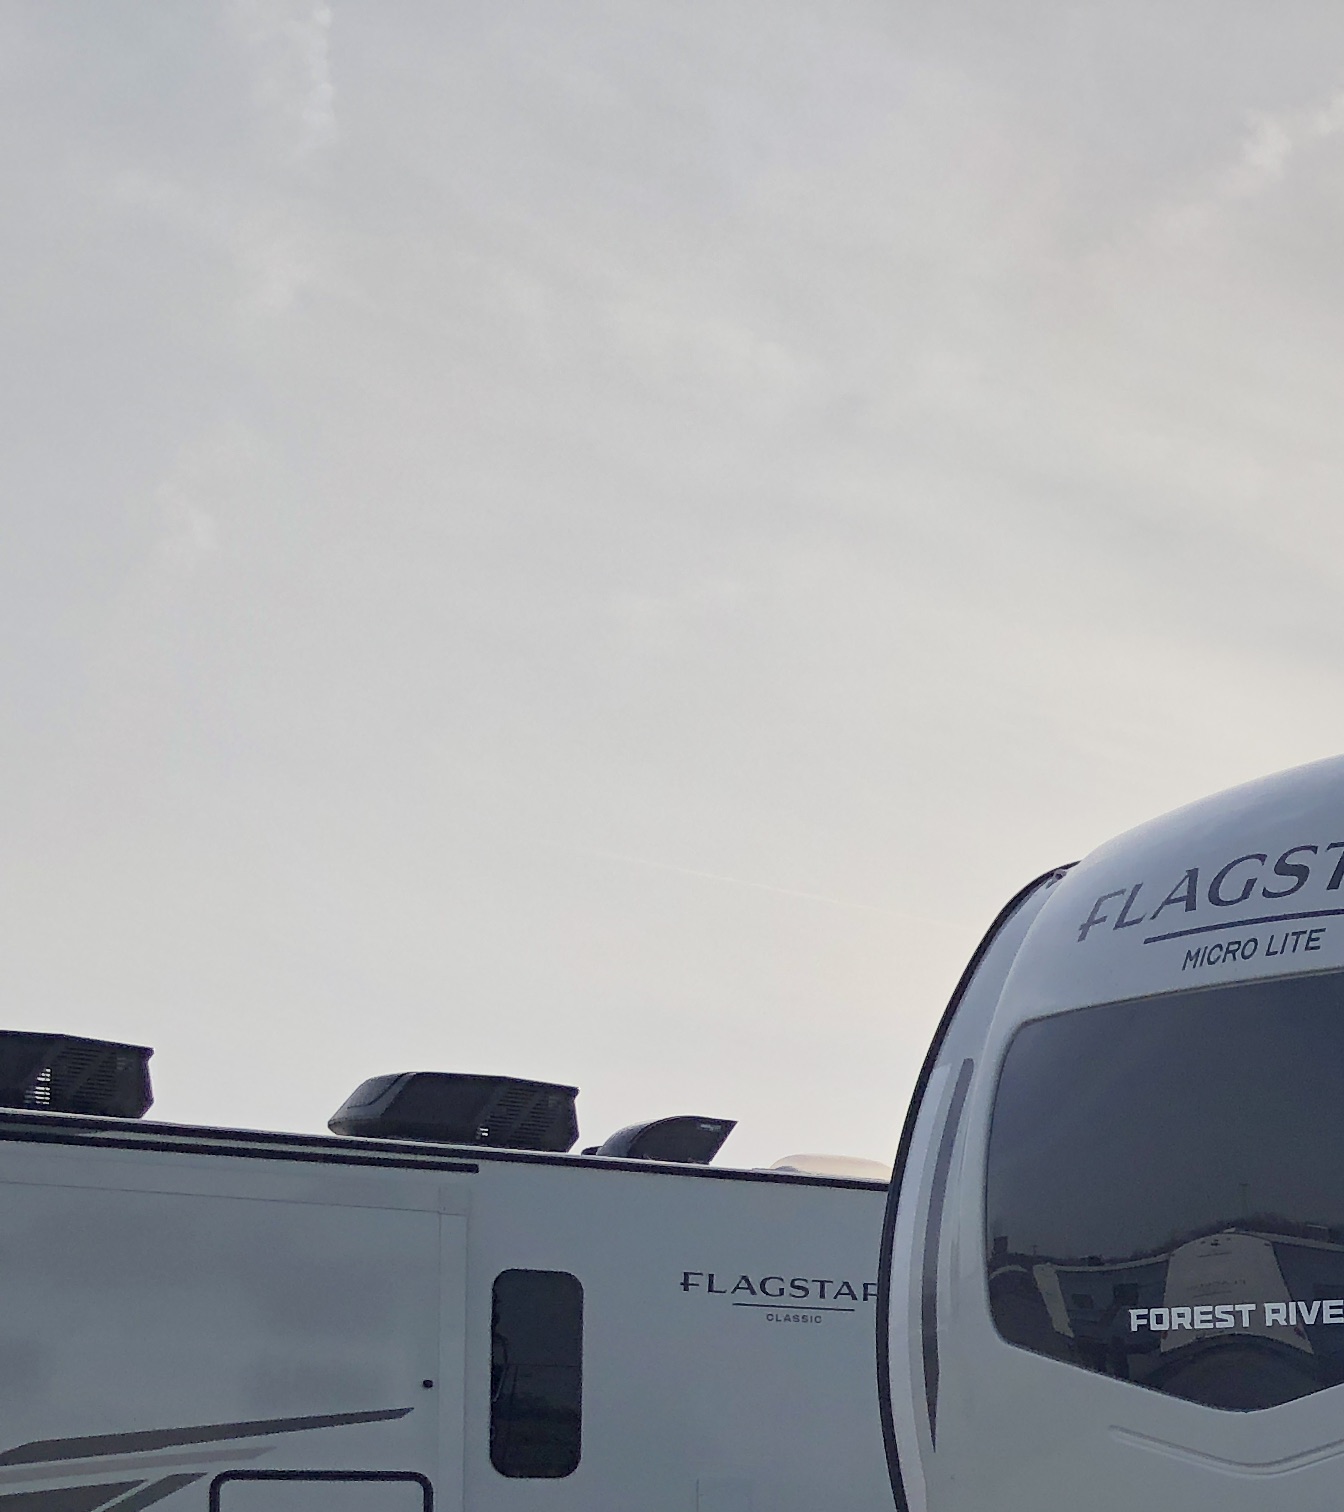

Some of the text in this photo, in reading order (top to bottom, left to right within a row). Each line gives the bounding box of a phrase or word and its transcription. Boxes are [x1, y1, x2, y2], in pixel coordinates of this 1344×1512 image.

[1181, 927, 1327, 971] MICRO LITE
[766, 1313, 823, 1324] CLASSIC
[1129, 1303, 1256, 1332] FOREST
